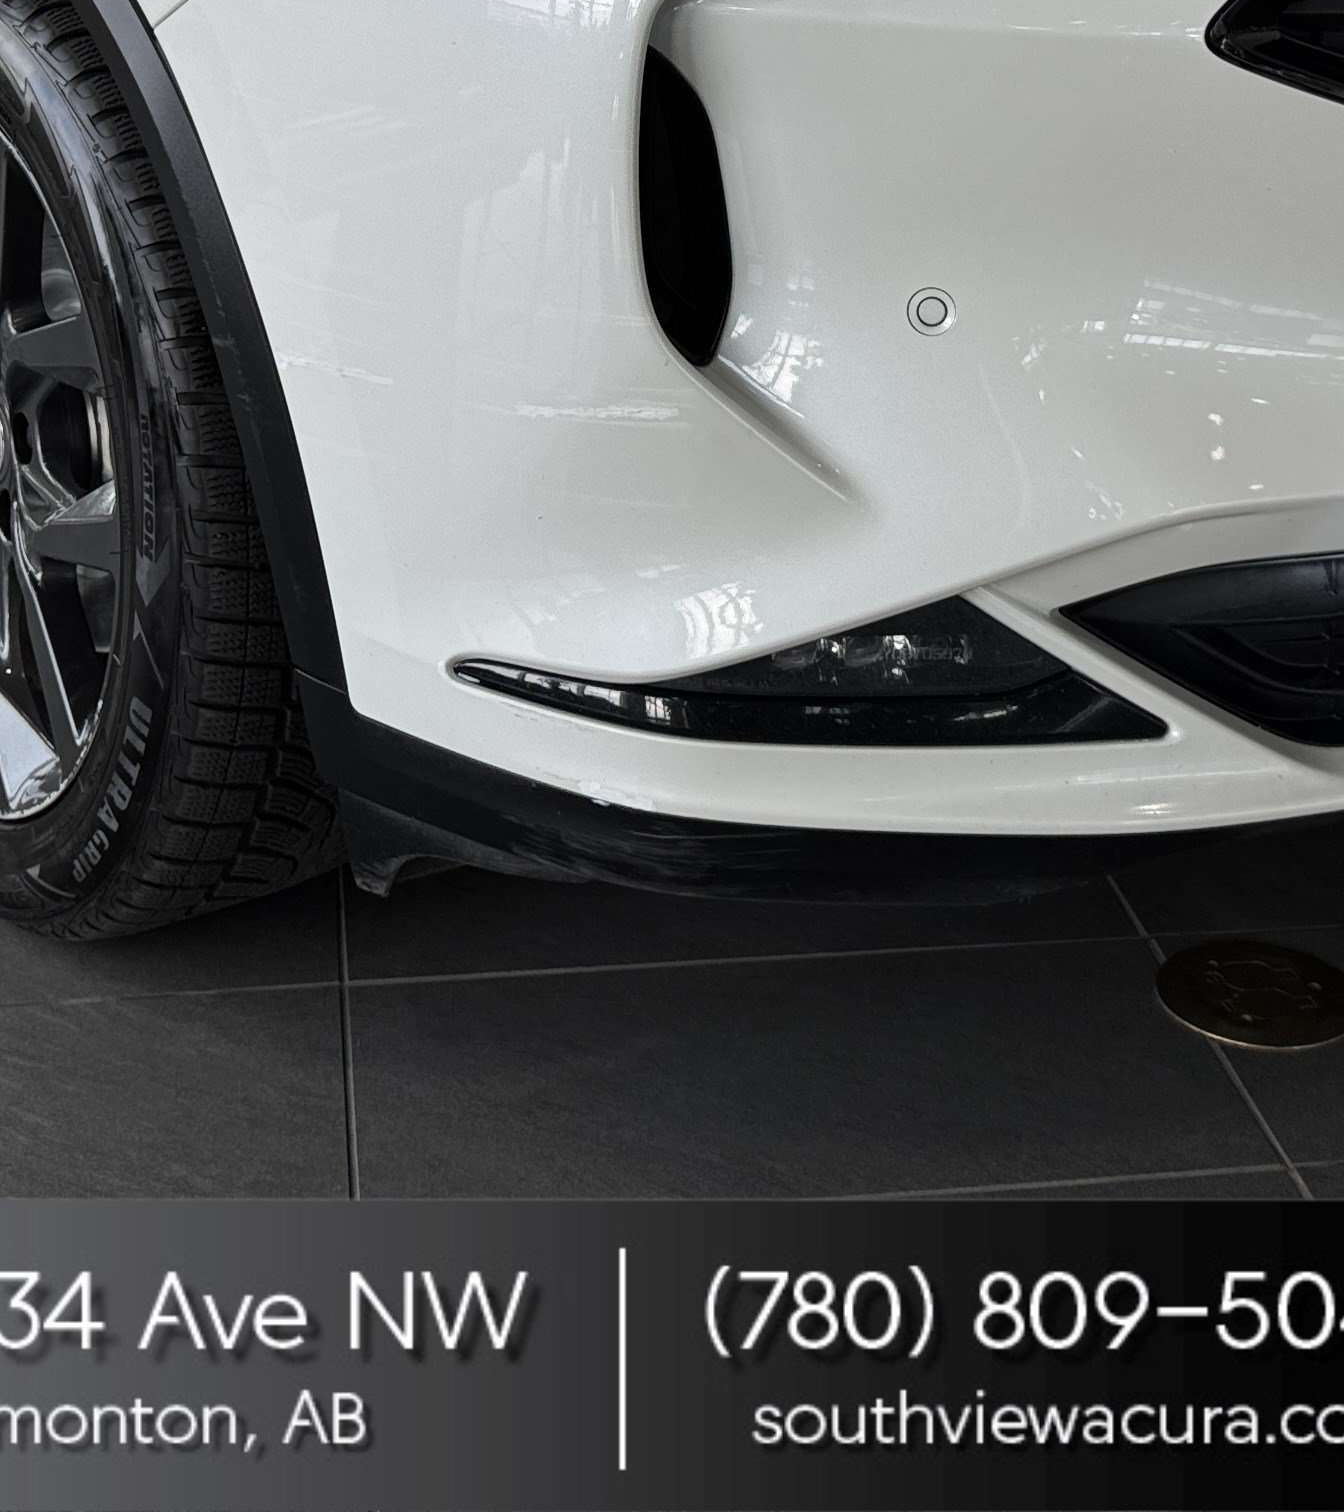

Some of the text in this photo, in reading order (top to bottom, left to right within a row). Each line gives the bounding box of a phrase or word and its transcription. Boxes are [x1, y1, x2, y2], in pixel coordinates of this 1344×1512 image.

[140, 413, 156, 562] ROTATION
[72, 695, 154, 884] ULTRA GRIP
